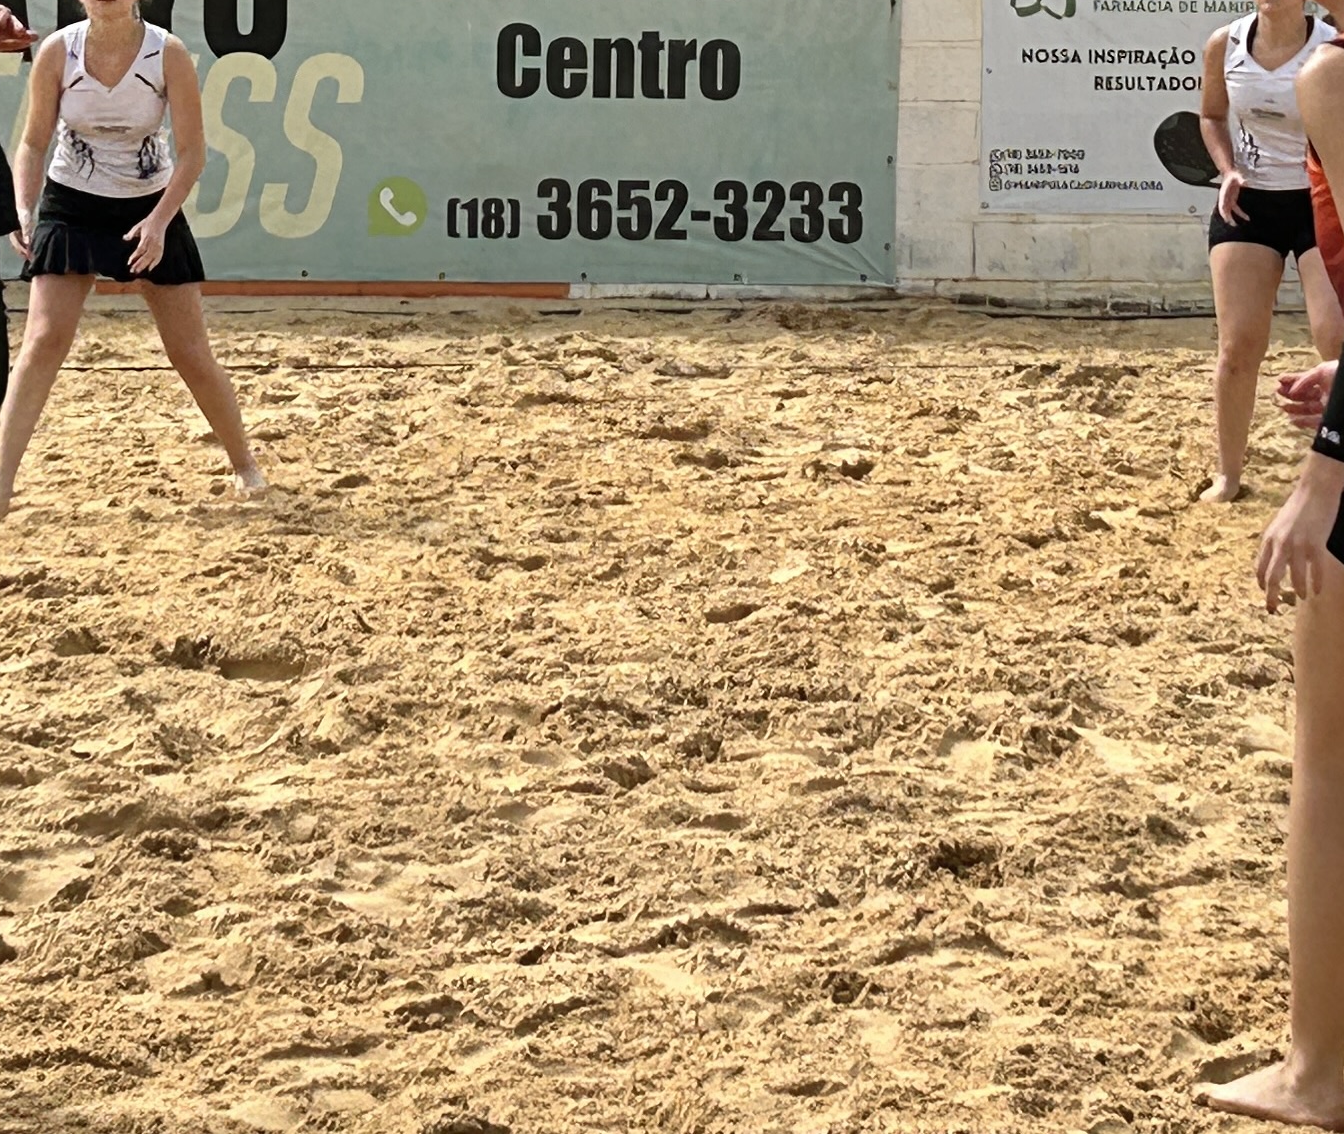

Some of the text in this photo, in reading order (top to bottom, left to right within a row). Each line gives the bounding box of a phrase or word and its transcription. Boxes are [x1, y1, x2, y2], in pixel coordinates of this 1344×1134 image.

[1179, 0, 1197, 13] DE
[496, 23, 741, 100] Centro
[1022, 47, 1196, 70] NOSSA INSPIRAÇÃO
[446, 178, 864, 244] (18) 3652-3233
